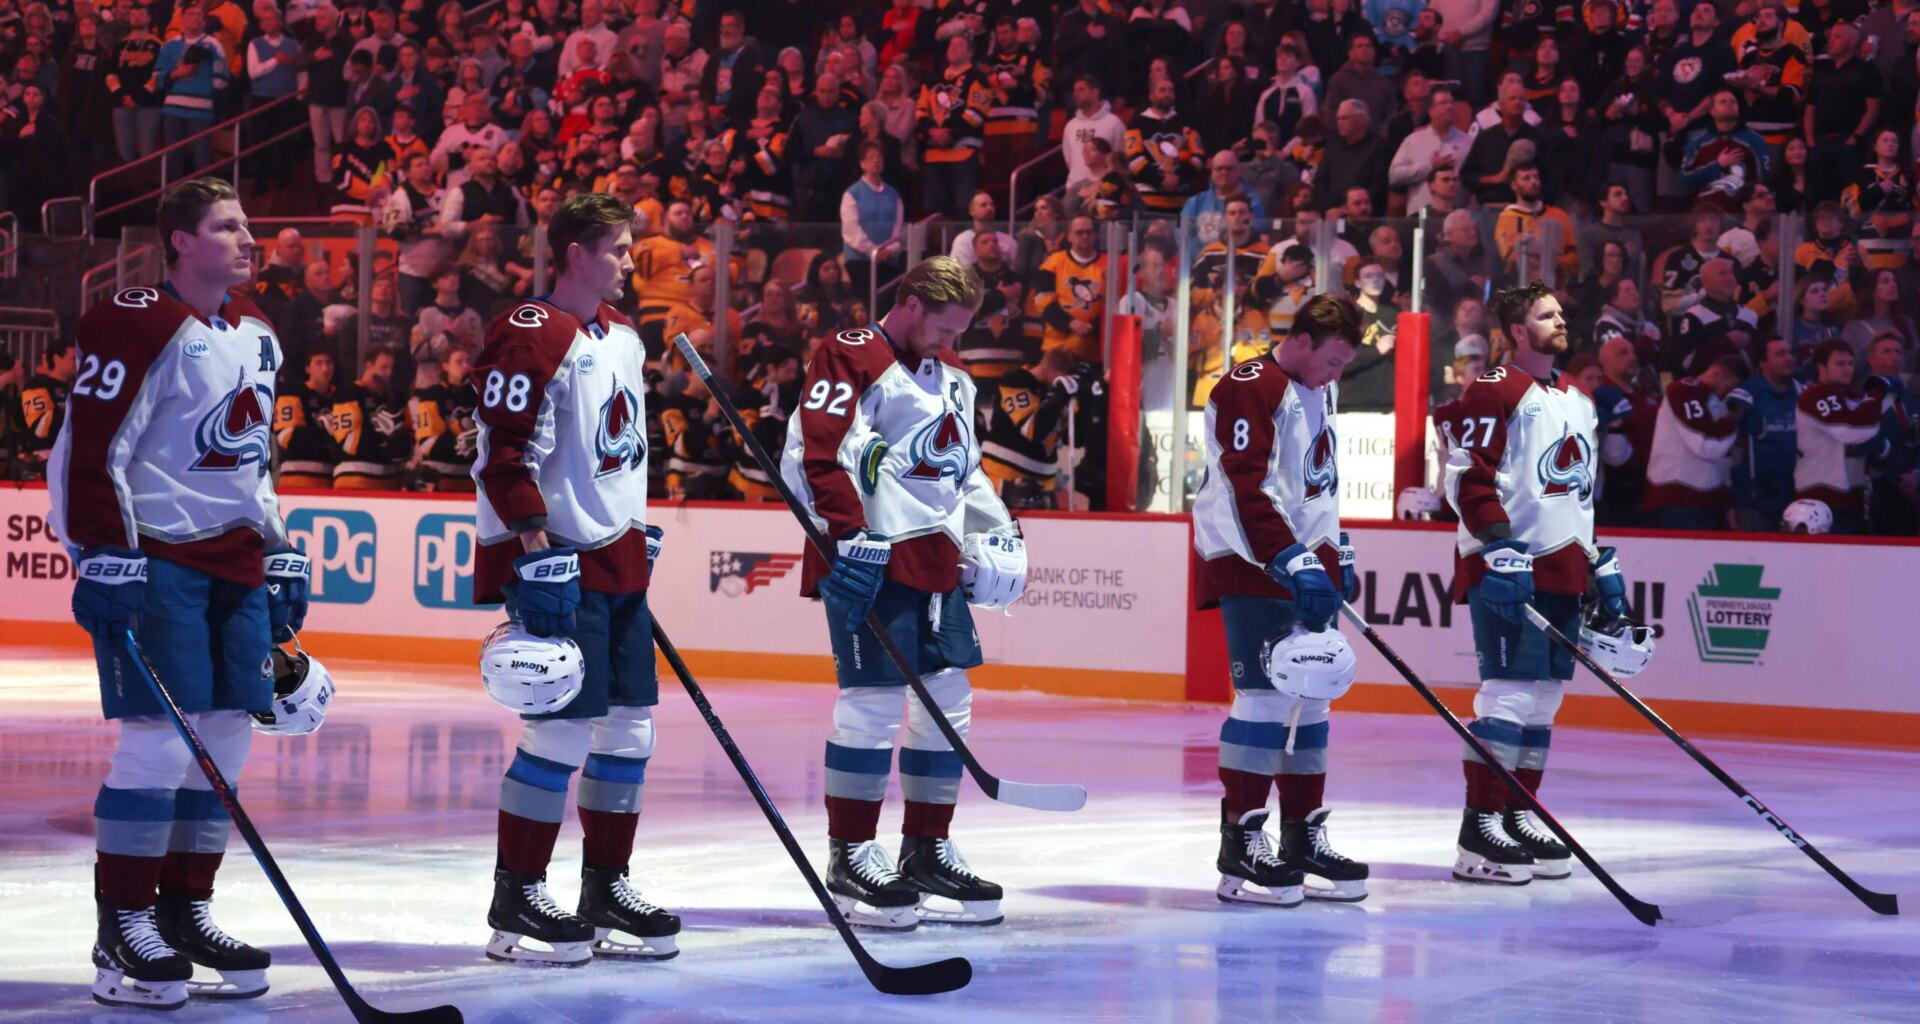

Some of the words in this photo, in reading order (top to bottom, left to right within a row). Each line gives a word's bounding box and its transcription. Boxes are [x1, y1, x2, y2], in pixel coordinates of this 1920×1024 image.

[258, 335, 276, 372] A
[73, 354, 126, 400] 29
[483, 369, 531, 412] 88
[803, 379, 854, 416] 92
[1006, 392, 1031, 413] 39
[1684, 400, 1704, 420] 13
[1816, 396, 1842, 417] 93
[1233, 418, 1249, 451] 8
[1461, 417, 1497, 447] 27
[1069, 568, 1090, 586] OF
[1093, 569, 1124, 587] THE
[1706, 610, 1772, 626] LOTTERY
[510, 660, 549, 675] Kiewit
[853, 634, 862, 670] BAUER
[113, 656, 123, 698] CCM
[1742, 795, 1807, 848] CCM
